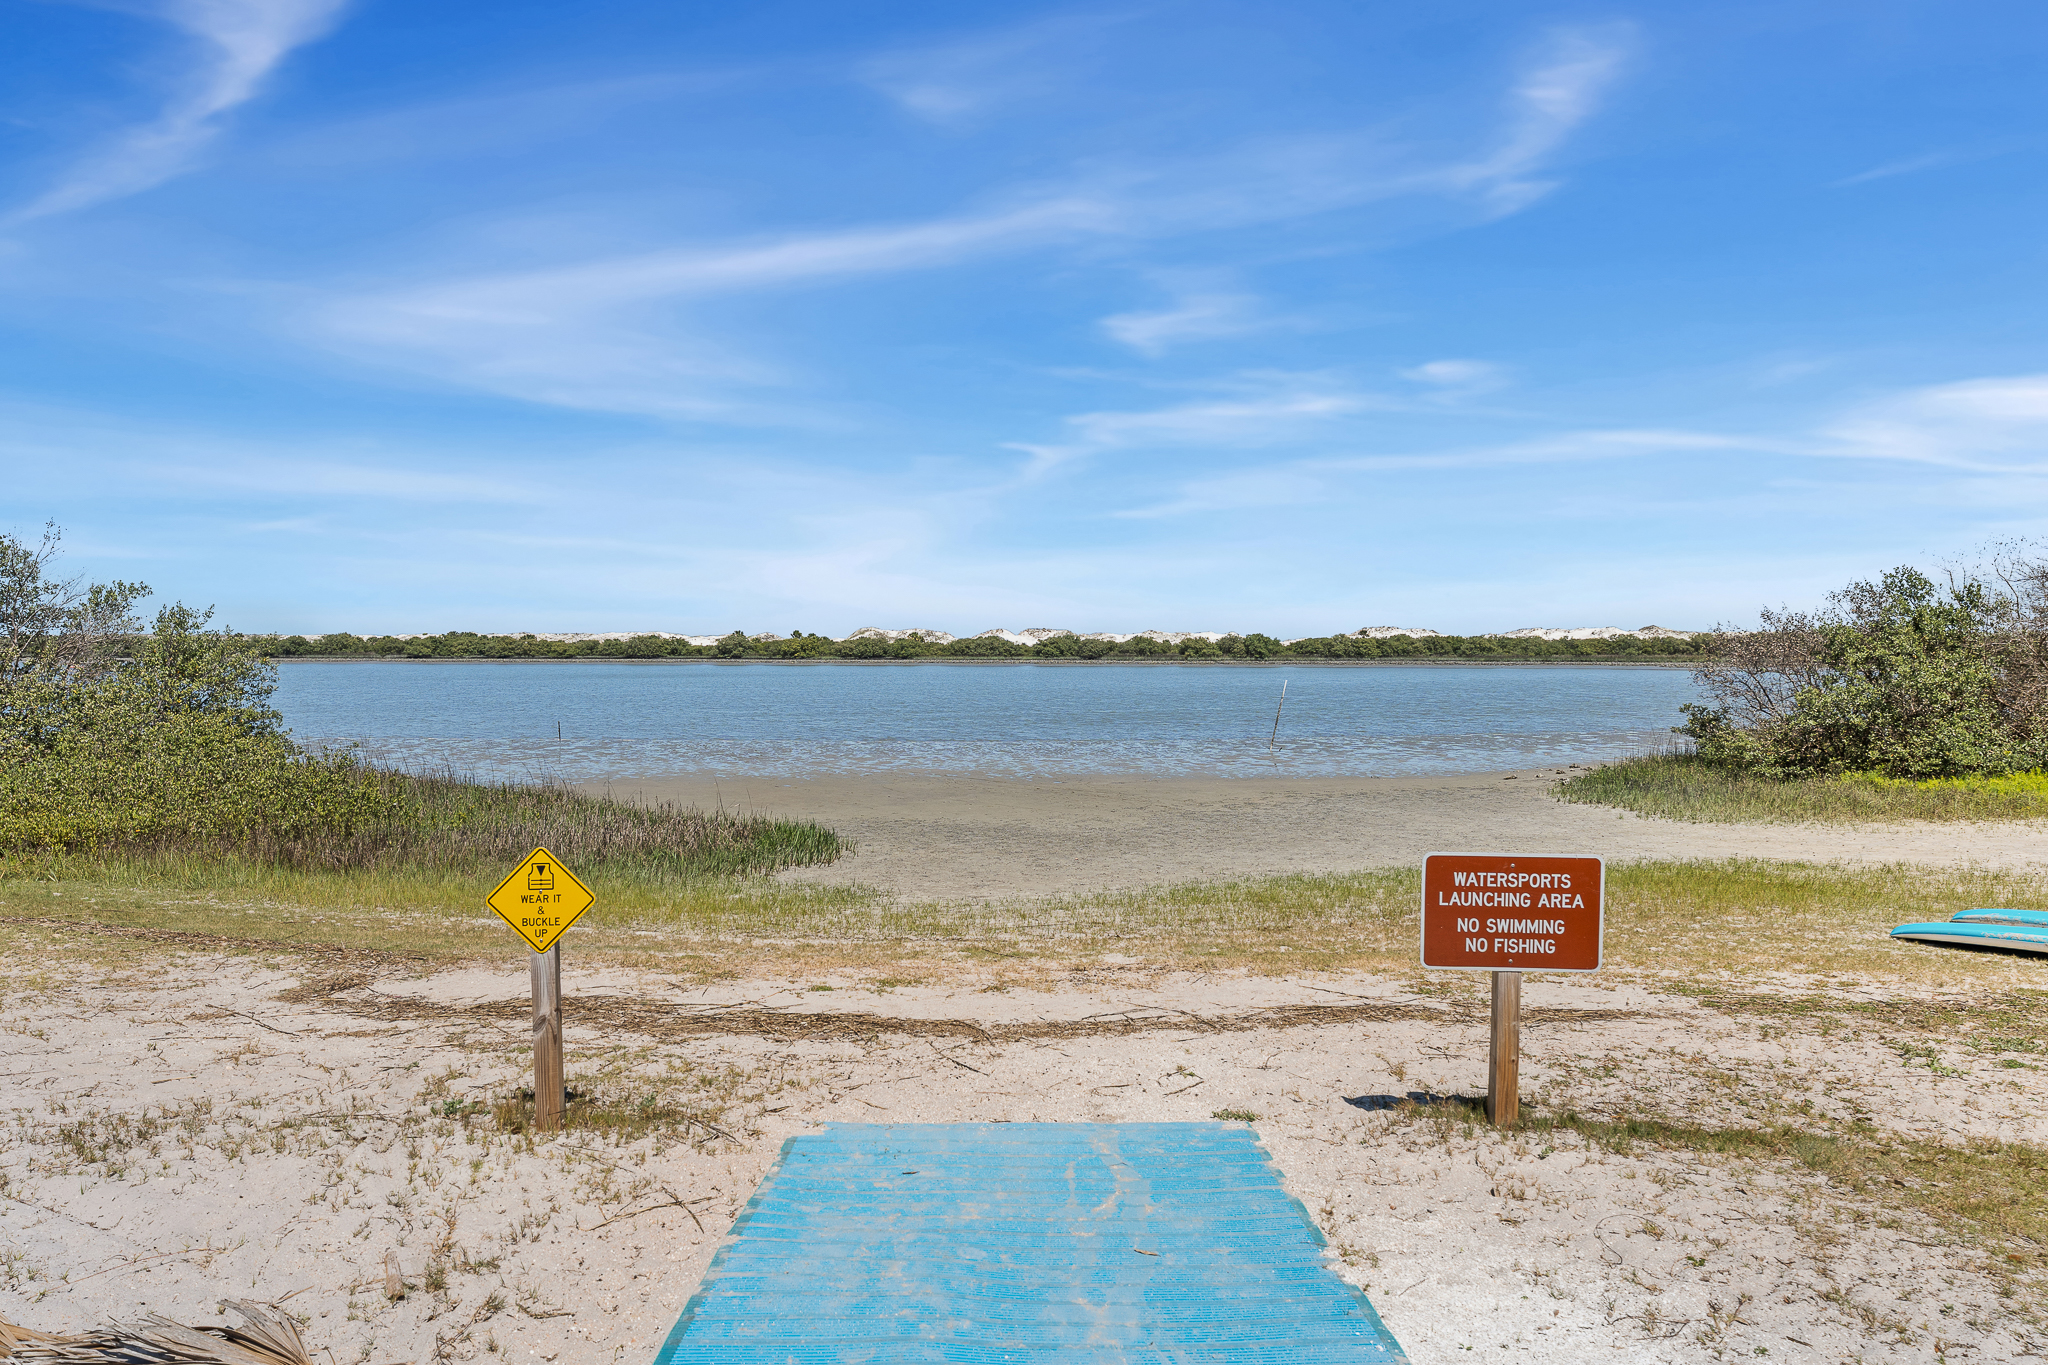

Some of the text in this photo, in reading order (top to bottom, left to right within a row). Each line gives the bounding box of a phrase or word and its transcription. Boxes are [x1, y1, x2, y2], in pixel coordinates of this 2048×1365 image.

[1454, 872, 1571, 888] WATERSPORTS
[521, 894, 561, 903] WEAR IT
[1439, 891, 1584, 908] LAUNCHING AREA
[537, 906, 545, 915] &
[522, 917, 560, 926] BUCKLE
[1457, 918, 1565, 934] NO SWIMMING
[535, 929, 548, 937] UP
[1465, 938, 1555, 953] NO FISHING
